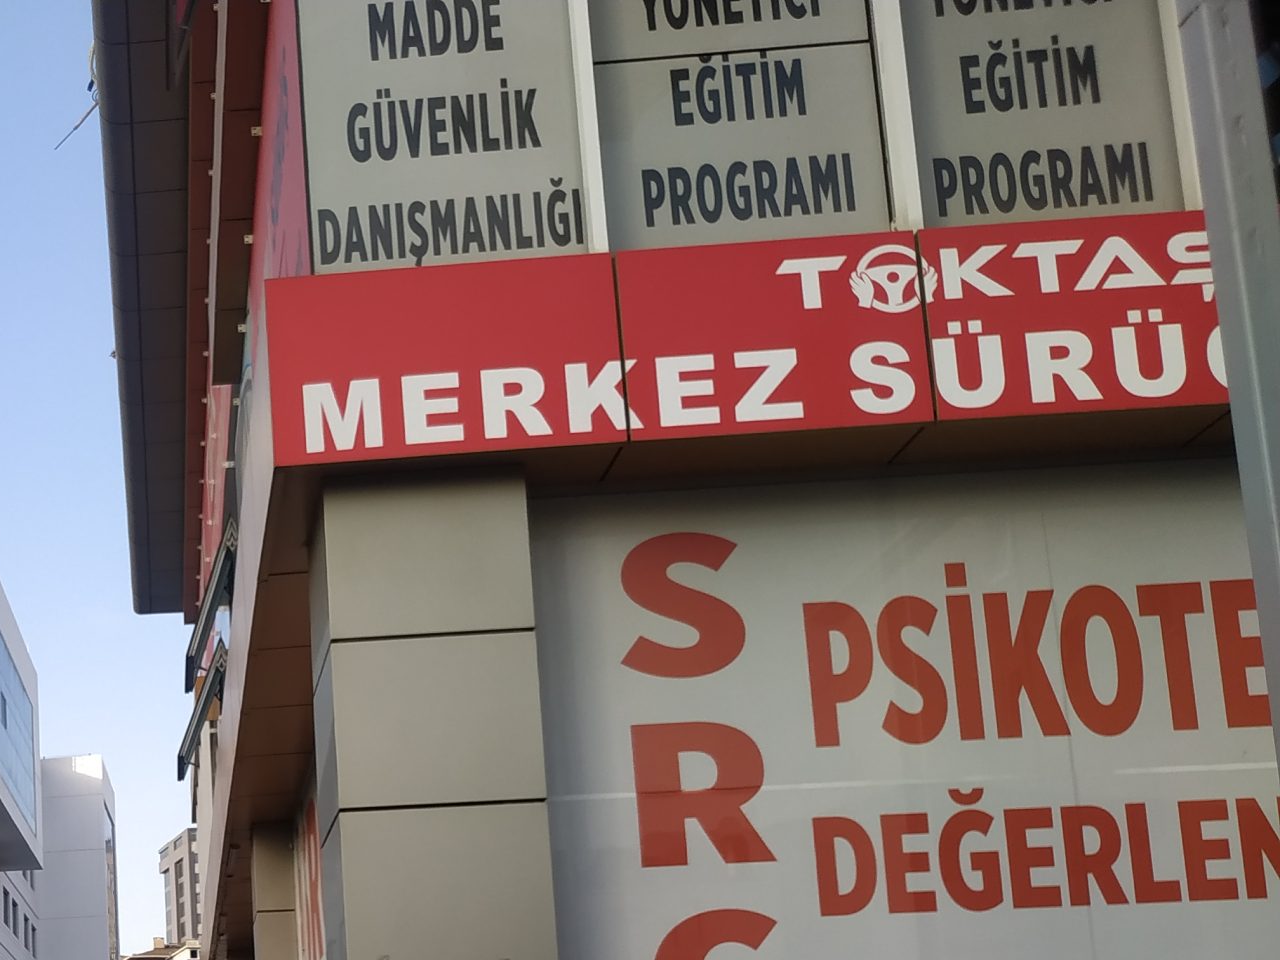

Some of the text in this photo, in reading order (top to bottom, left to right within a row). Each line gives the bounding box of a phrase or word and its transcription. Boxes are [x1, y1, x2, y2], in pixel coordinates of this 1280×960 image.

[367, 0, 504, 61] MADDE
[670, 52, 807, 126] EĞİTİM
[959, 35, 1101, 114] EĞİTİM
[347, 78, 542, 163] GÜVENLİK
[641, 153, 856, 227] PROGRAMI
[932, 142, 1154, 217] PROGRAMI
[317, 177, 584, 266] DANIŞMANLIĞI
[302, 309, 1228, 454] MERKEZ SÜRÜ
[802, 562, 1273, 748] PSİKOTE
[811, 787, 1280, 917] DEĞERLEN
